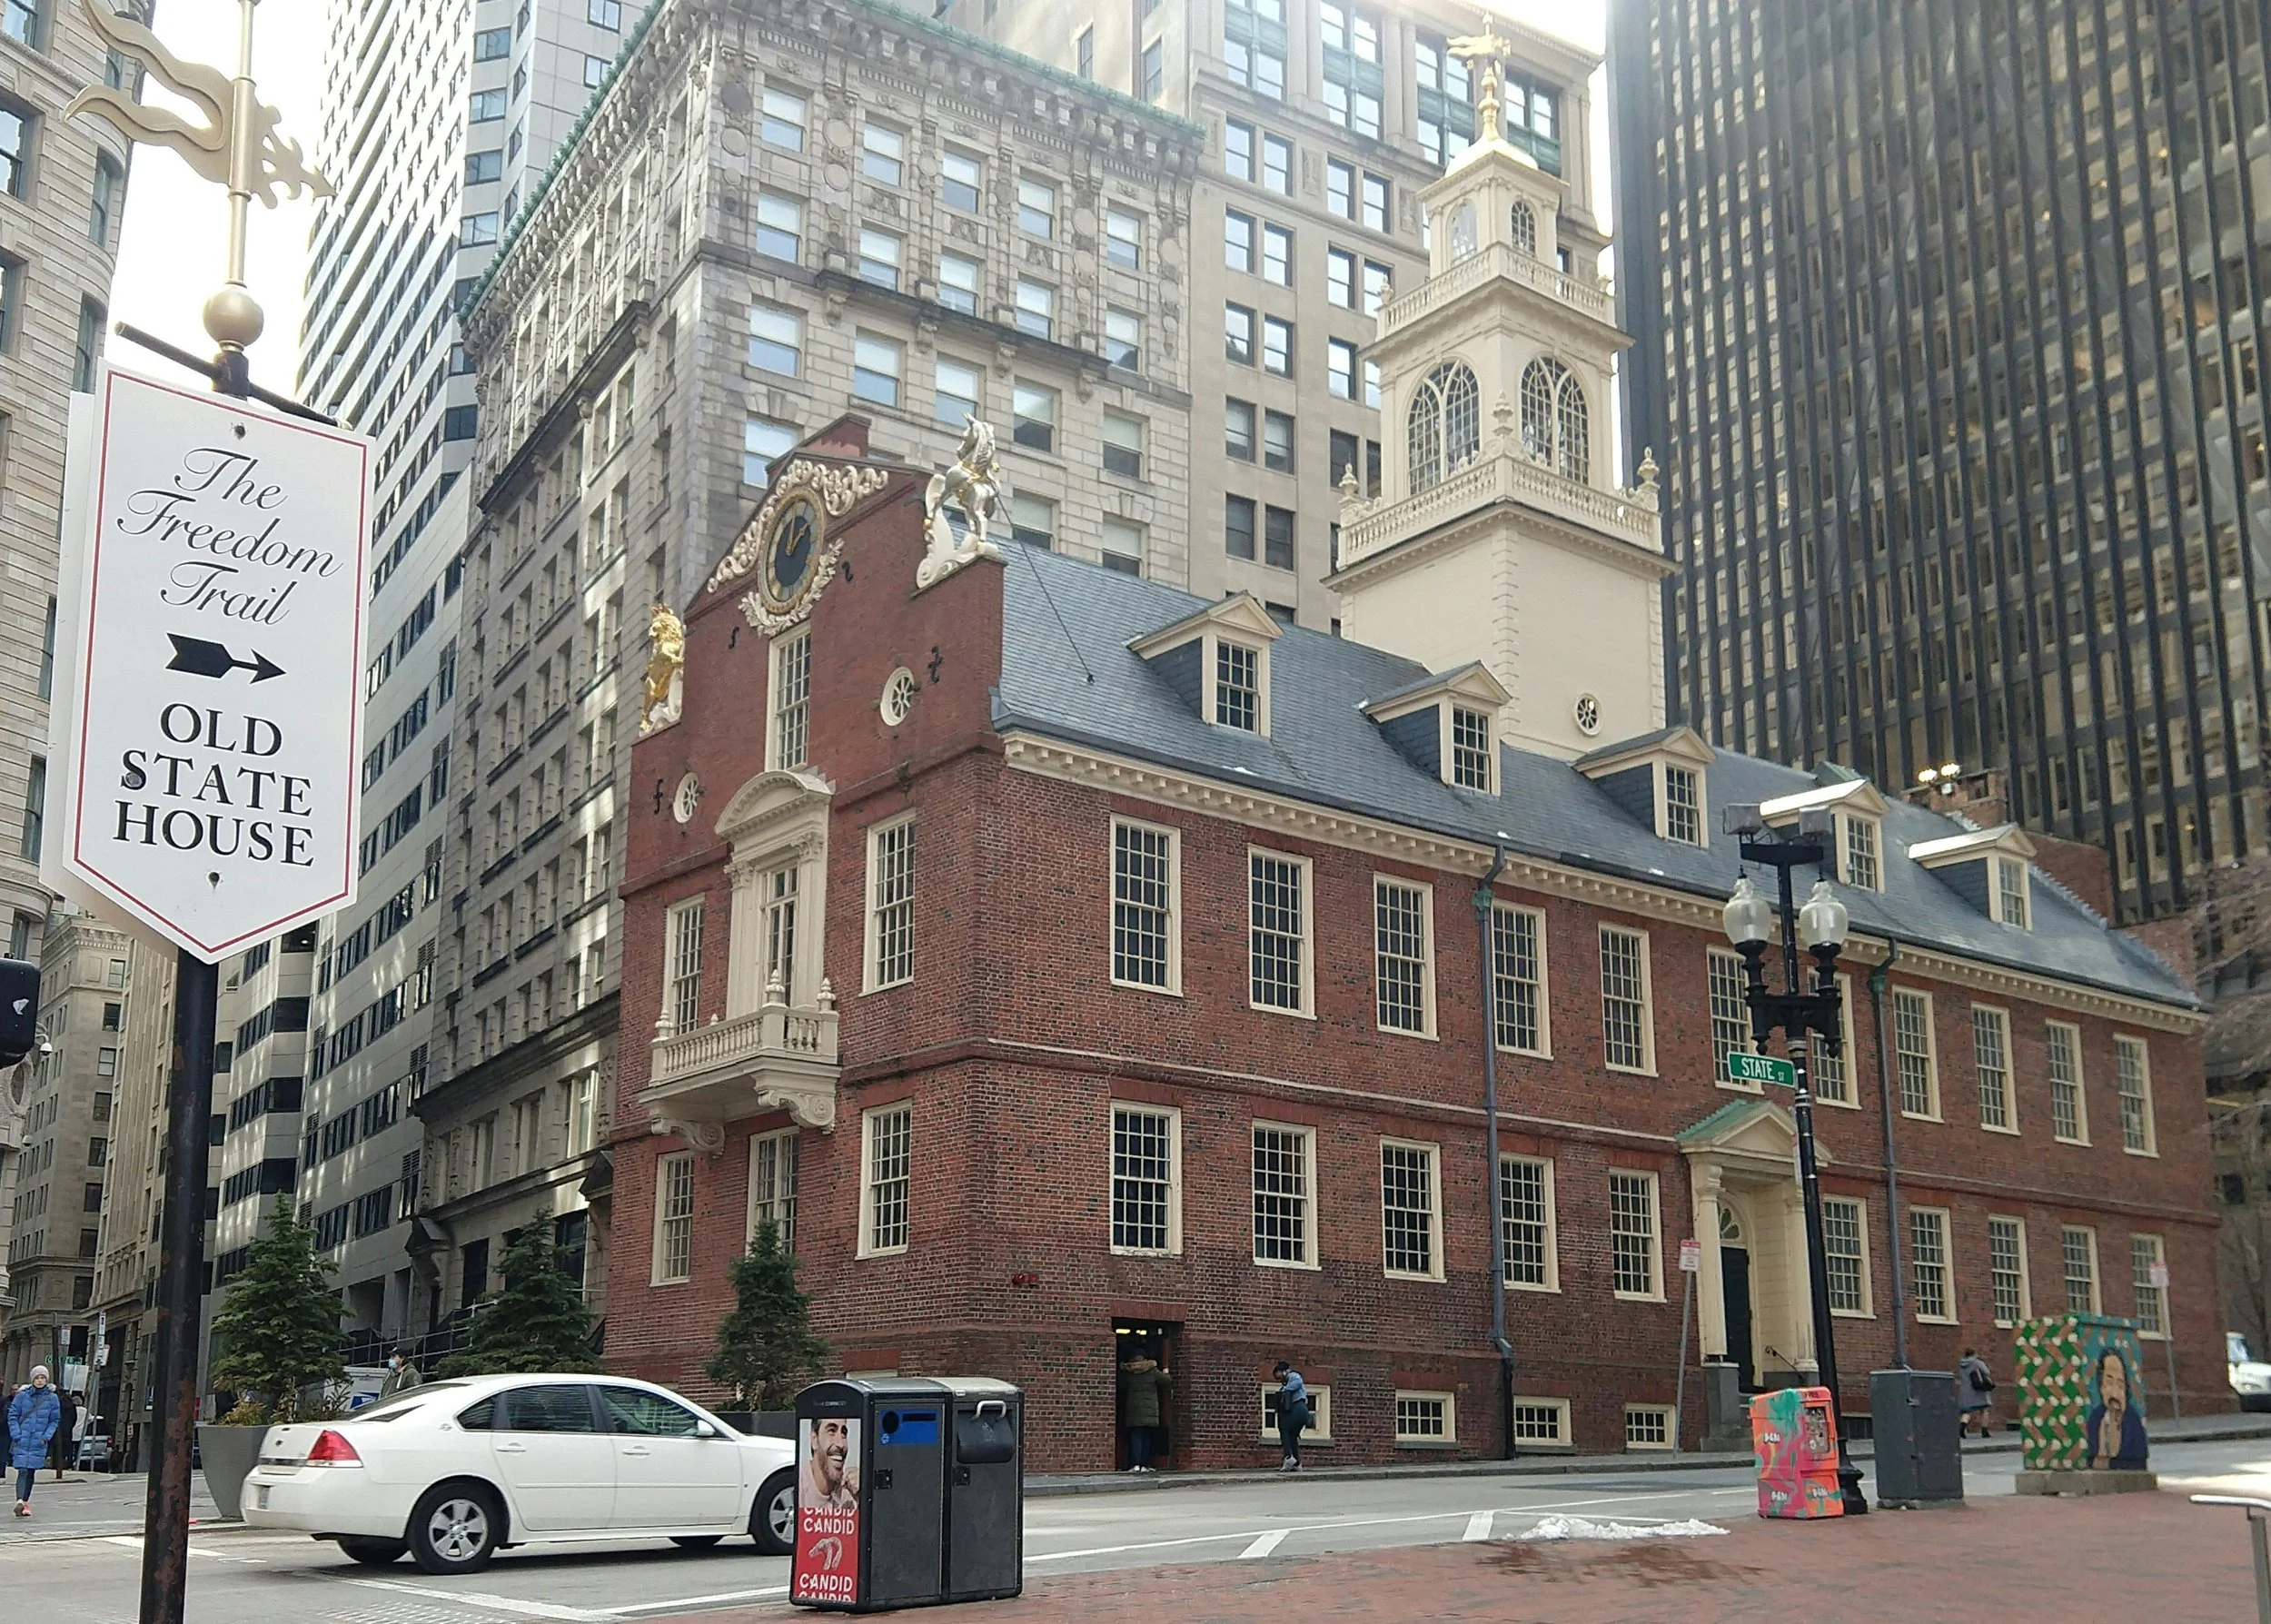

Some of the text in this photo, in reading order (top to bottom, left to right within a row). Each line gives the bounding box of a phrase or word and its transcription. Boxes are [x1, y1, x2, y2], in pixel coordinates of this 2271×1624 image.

[174, 448, 288, 510] The
[116, 490, 344, 578] Freedom
[160, 561, 298, 626] Trail
[160, 702, 283, 757] OLD
[120, 749, 312, 817] STATE
[113, 800, 314, 867] HOUSE
[1741, 1057, 1775, 1080] STATE
[803, 1518, 855, 1535] CANDID
[799, 1573, 853, 1592] CANDID
